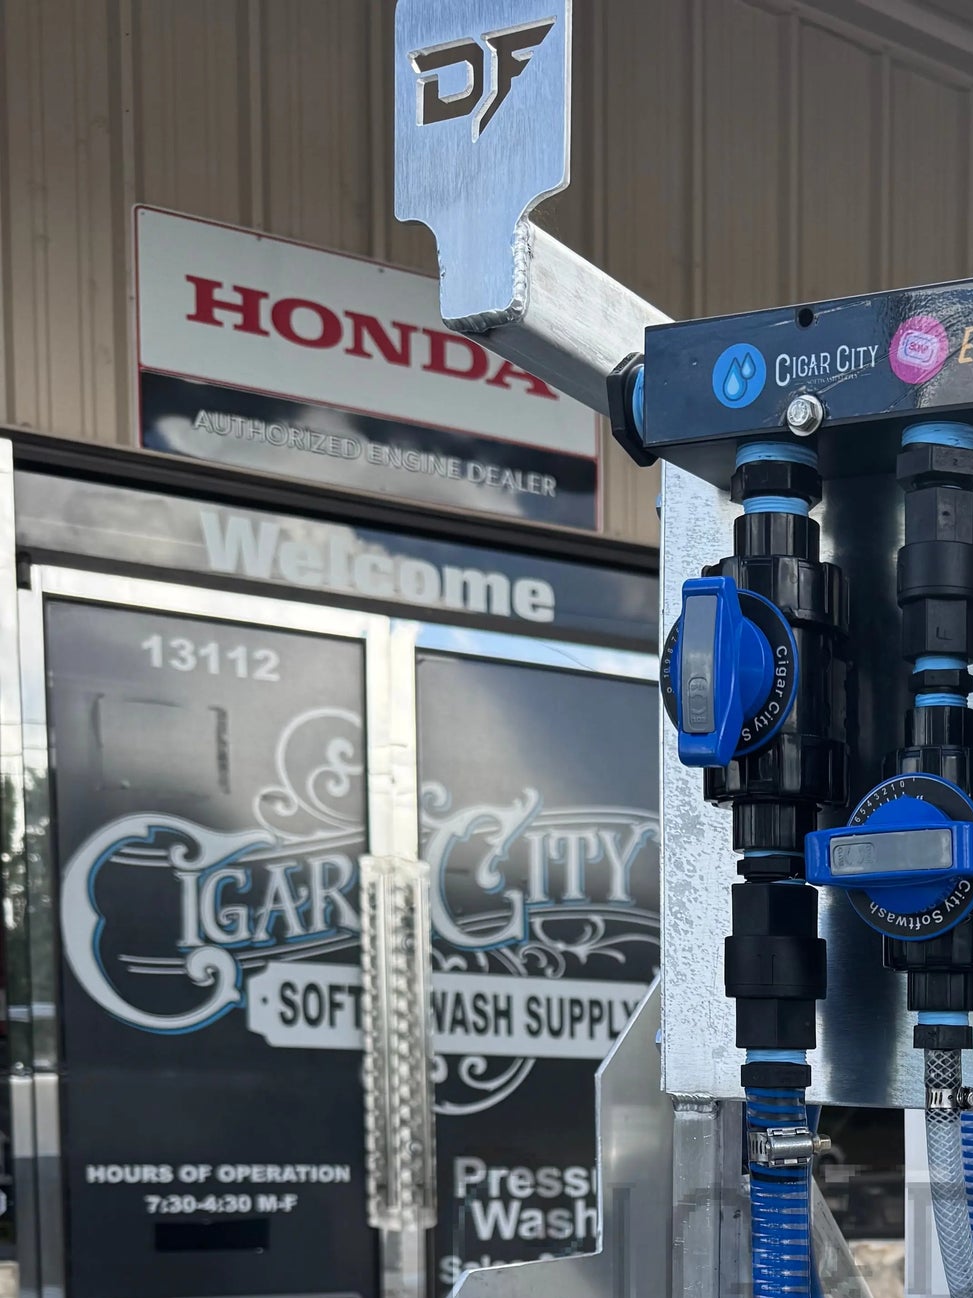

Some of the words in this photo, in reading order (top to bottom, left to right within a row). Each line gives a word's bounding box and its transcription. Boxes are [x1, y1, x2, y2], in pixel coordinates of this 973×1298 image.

[407, 15, 557, 143] DF
[185, 274, 561, 401] HONDA
[774, 353, 831, 388] CIGAR
[836, 344, 880, 376] CITY
[194, 409, 362, 461] AUTHORIZED
[367, 443, 461, 481] ENGINE
[466, 461, 557, 498] DEALER
[201, 510, 556, 624] Welcome
[140, 634, 281, 682] 13112
[775, 644, 790, 698] Cigar
[754, 701, 780, 732] City
[61, 811, 361, 1035] CIGAR
[427, 786, 655, 950] CITY
[869, 901, 944, 931] Softwash
[944, 879, 971, 912] City
[279, 981, 363, 1030] SOFT
[86, 1164, 174, 1184] HOURS
[178, 1164, 213, 1183] OF
[216, 1164, 351, 1184] OPERATION
[454, 1156, 597, 1199] Press
[145, 1194, 252, 1214] 7:30-4:30
[256, 1194, 299, 1213] M-F
